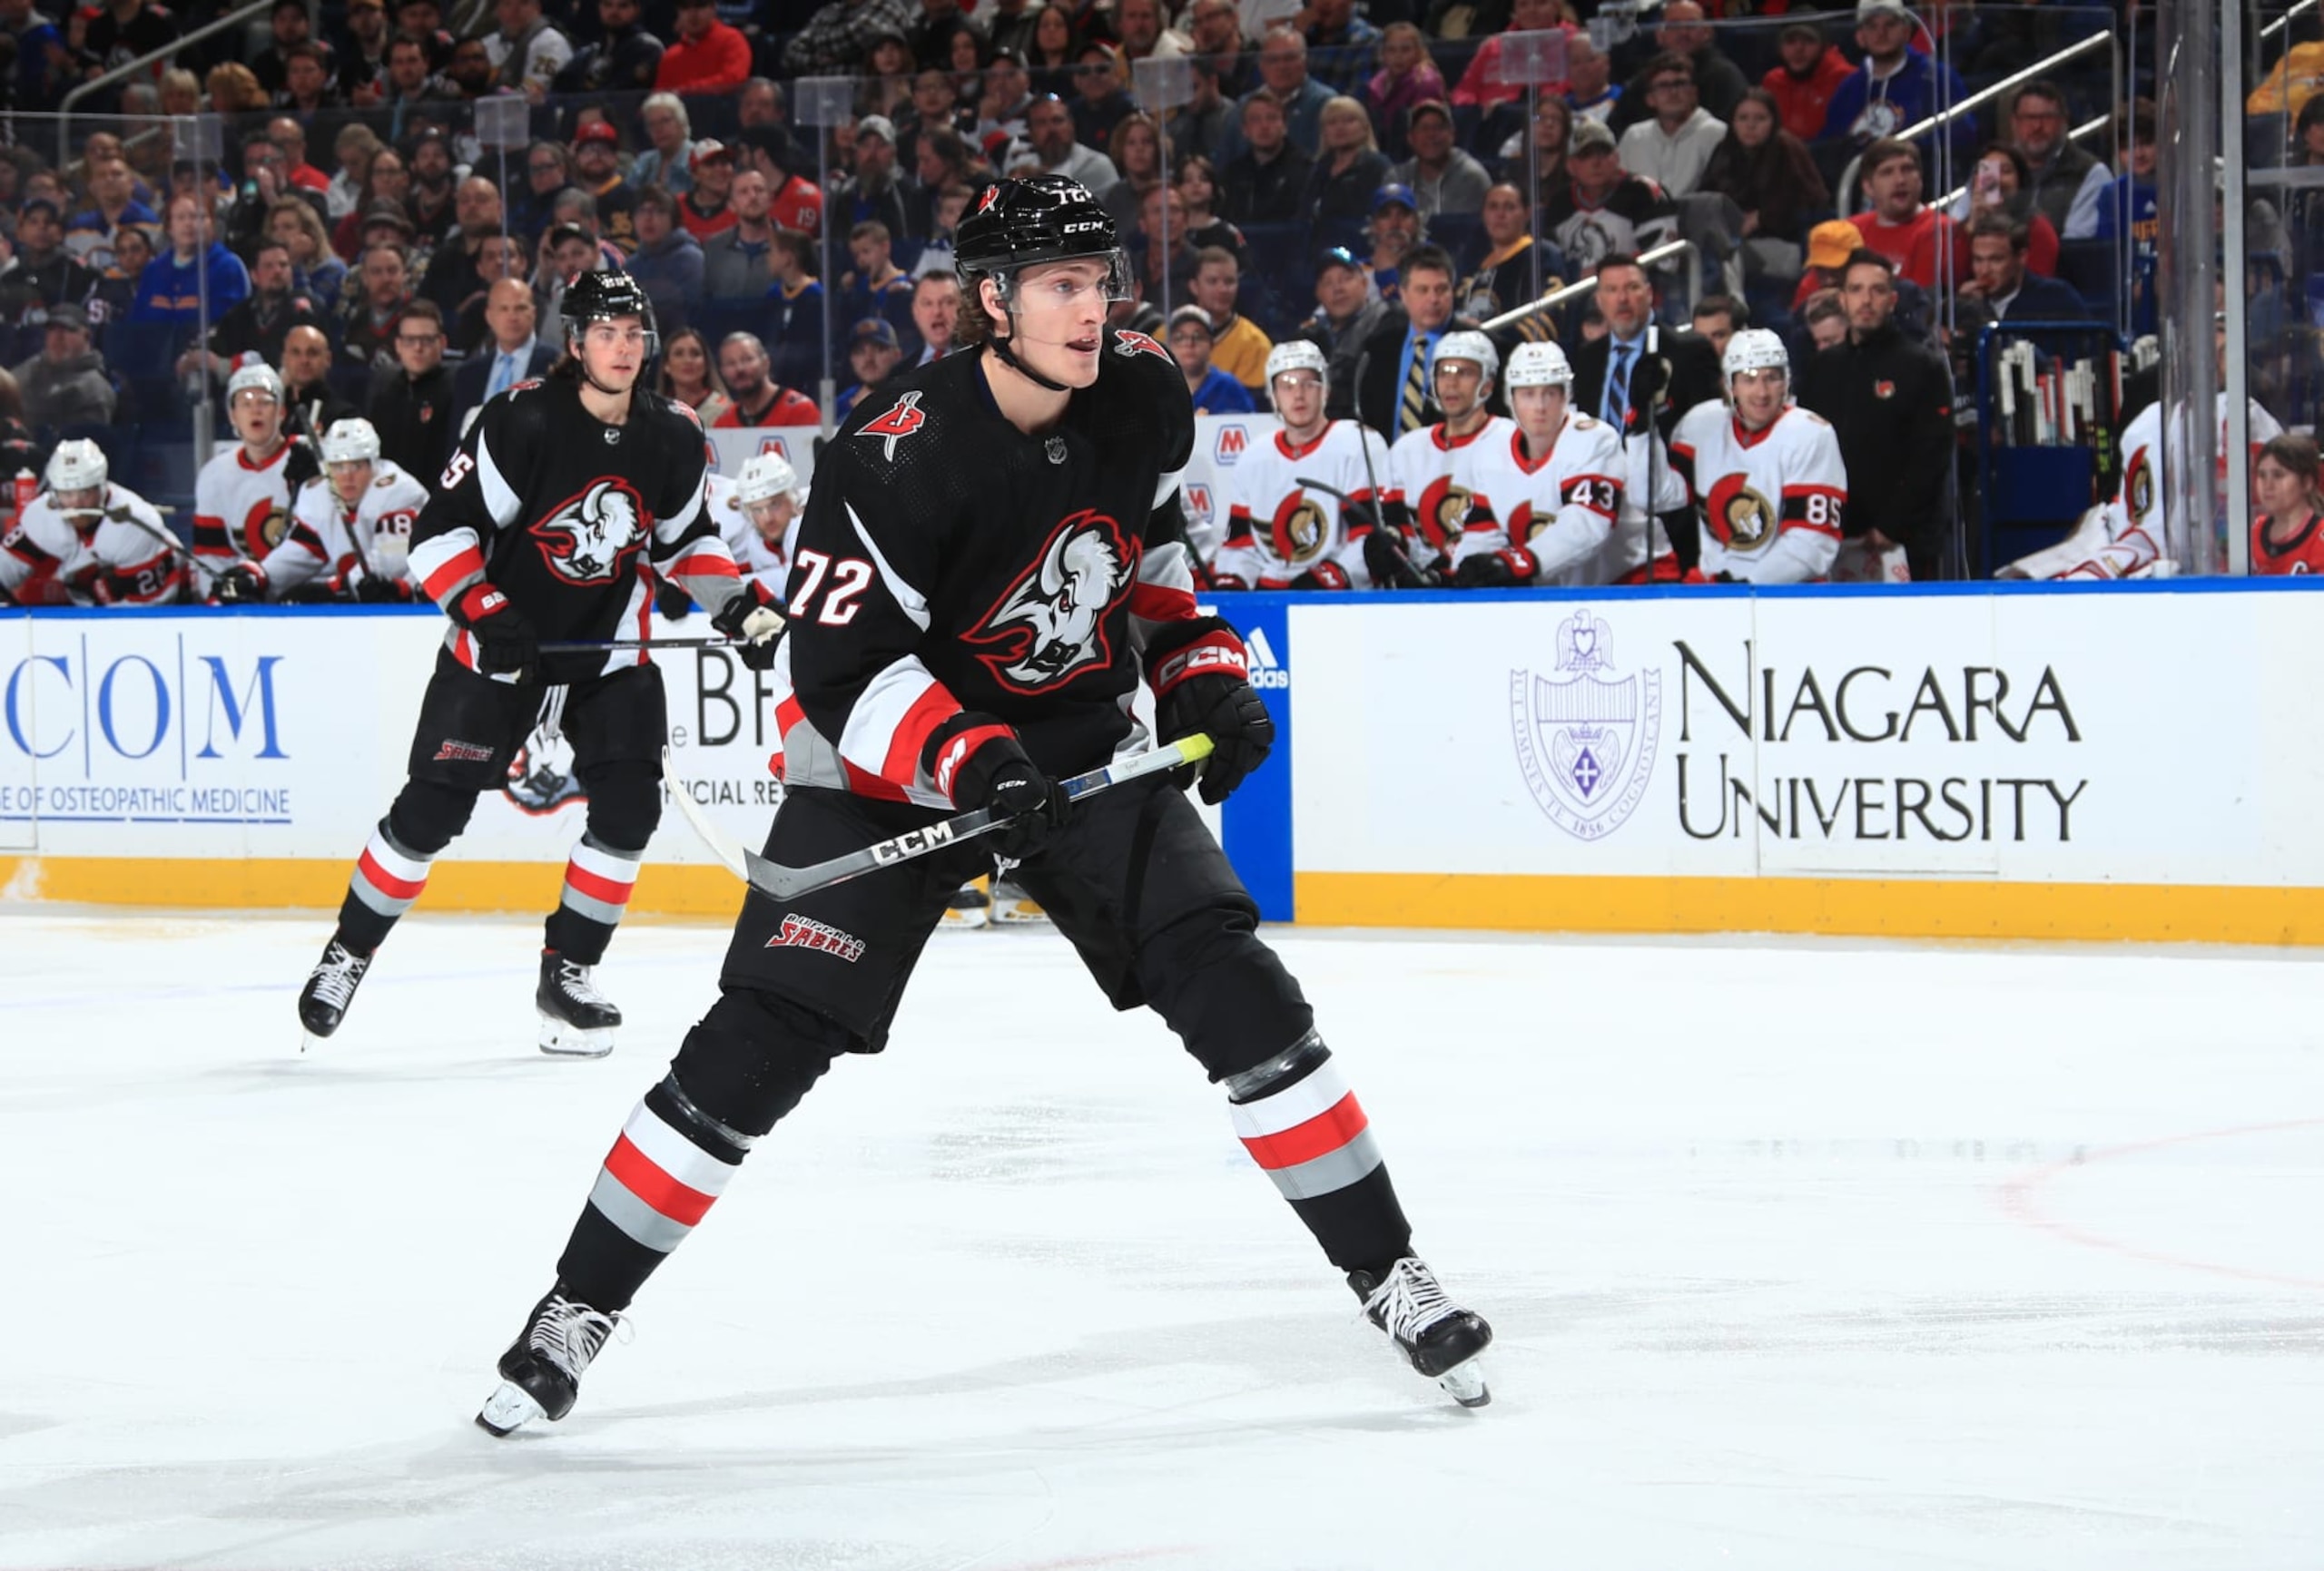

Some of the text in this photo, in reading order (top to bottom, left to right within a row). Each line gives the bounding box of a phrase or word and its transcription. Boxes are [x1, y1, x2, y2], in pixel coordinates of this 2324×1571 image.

[1064, 221, 1104, 234] CCM
[1571, 478, 1615, 511] 43
[1806, 493, 1842, 529] 85
[379, 514, 413, 535] 18
[788, 548, 876, 626] 72
[1159, 645, 1247, 687] CCM
[1671, 639, 2083, 742] NIAGARA
[17, 787, 44, 810] OF
[51, 787, 185, 812] OSTEOPATHIC
[192, 789, 290, 813] MEDICINE
[997, 780, 1028, 791] CCM
[1676, 753, 2089, 842] UNIVERSITY
[870, 820, 954, 866] CCM
[1571, 819, 1605, 838] 1856
[763, 920, 862, 963] SABRES
